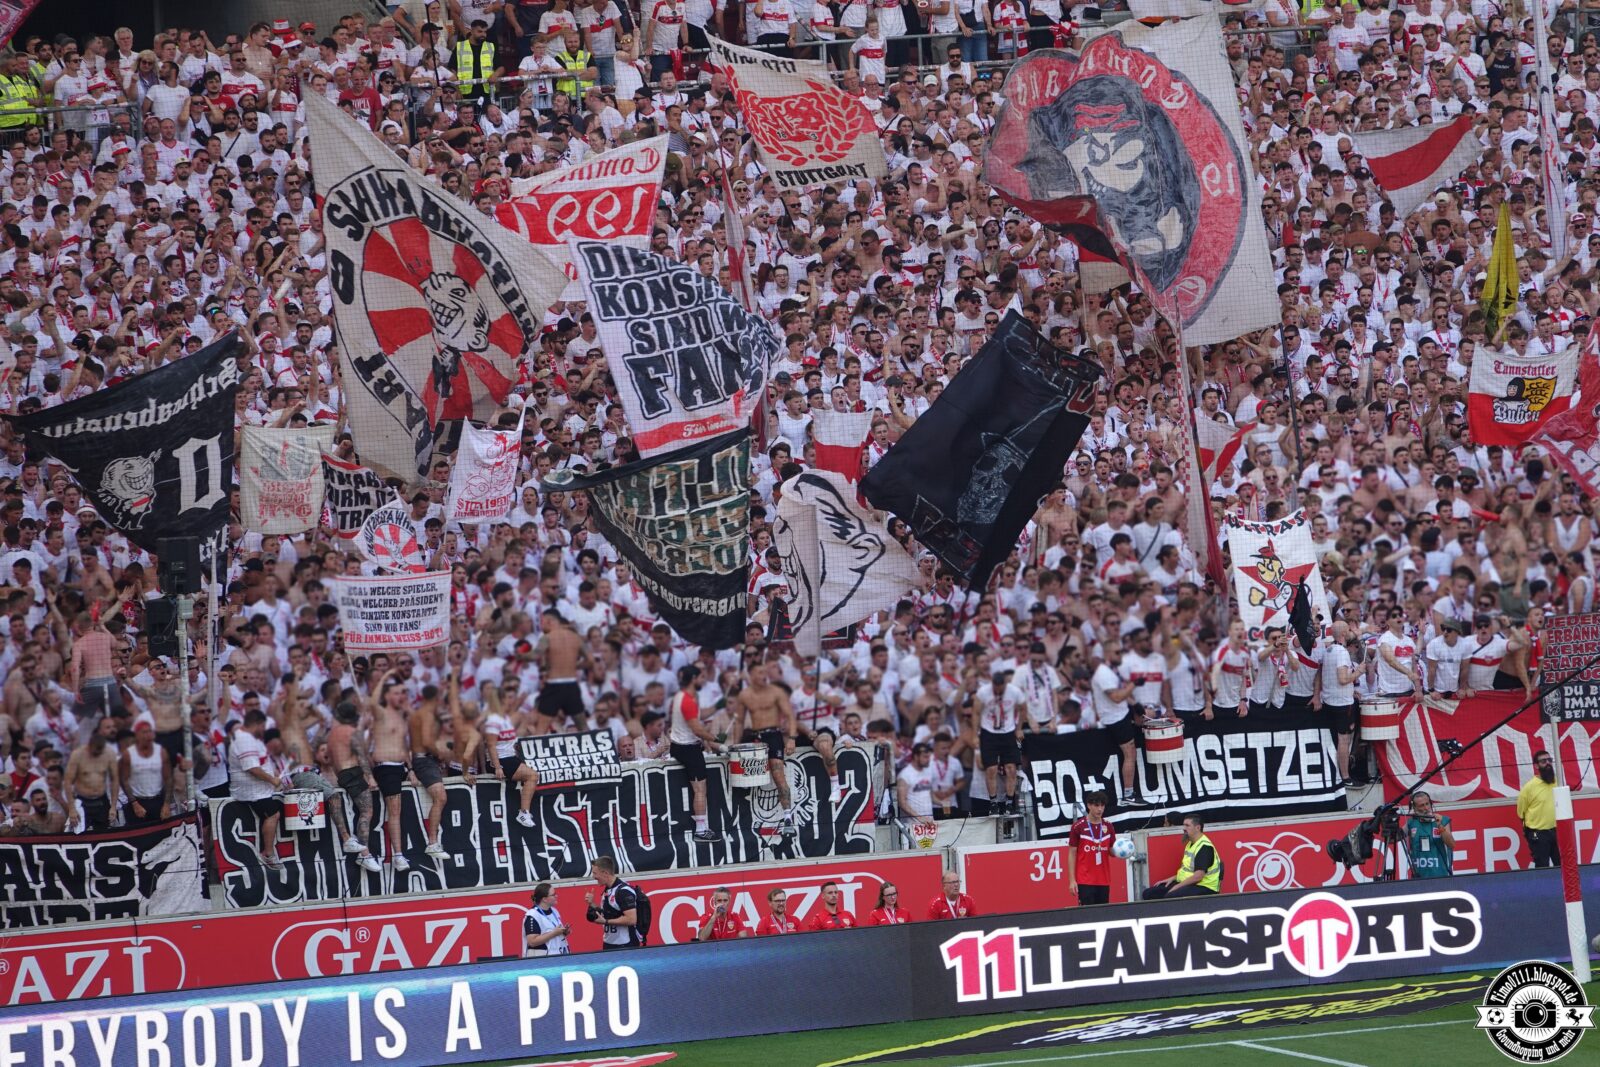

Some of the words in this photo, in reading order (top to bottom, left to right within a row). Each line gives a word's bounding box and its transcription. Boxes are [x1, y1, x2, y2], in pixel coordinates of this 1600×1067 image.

[775, 163, 868, 188] STUTTGART
[580, 244, 659, 281] DIE
[627, 305, 715, 355] SIND
[1493, 400, 1541, 423] Buben
[1227, 510, 1306, 536] ULTRAS
[362, 597, 398, 608] WELCHER
[370, 586, 401, 596] WELCHE
[360, 610, 389, 620] EINZIGE
[391, 606, 437, 619] KONSTANTE
[344, 631, 362, 643] FÜR
[365, 632, 394, 643] IMMER
[395, 627, 443, 642] WEISS-ROT!
[364, 622, 383, 632] SIND
[385, 622, 398, 633] WIR
[399, 620, 422, 632] FANS!
[1563, 685, 1584, 697] DU
[1564, 709, 1586, 719] BEI
[520, 730, 613, 760] ULTRAS
[524, 749, 616, 772] BEDEUTET
[1136, 728, 1343, 805] UMSETZEN
[536, 763, 621, 785] IDERSTAND
[1029, 850, 1063, 882] 34
[347, 986, 407, 1063] IS
[445, 981, 482, 1052] A
[517, 965, 641, 1046] PRO
